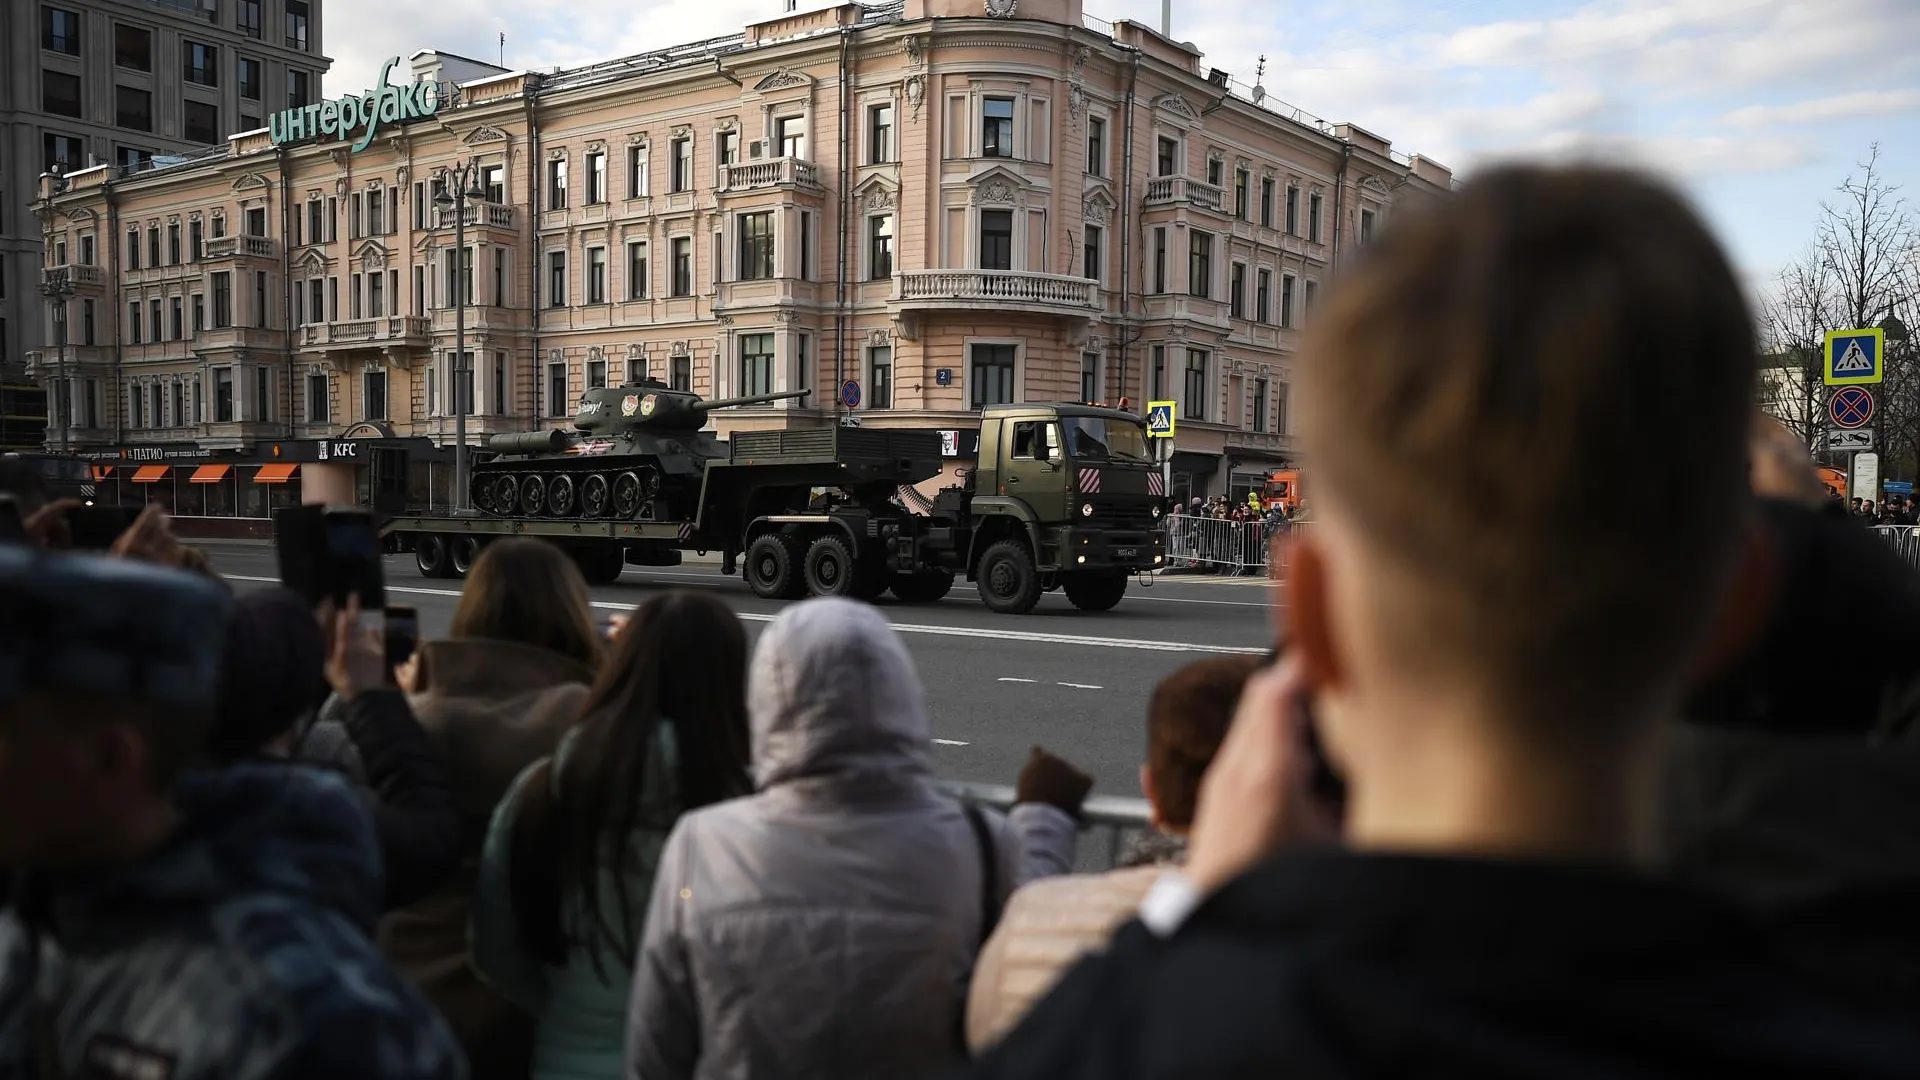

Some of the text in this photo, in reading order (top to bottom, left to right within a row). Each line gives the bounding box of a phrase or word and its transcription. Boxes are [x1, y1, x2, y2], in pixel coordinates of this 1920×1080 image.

[940, 371, 946, 380] 2
[134, 447, 163, 461] ПАТИО
[333, 443, 356, 457] KFC
